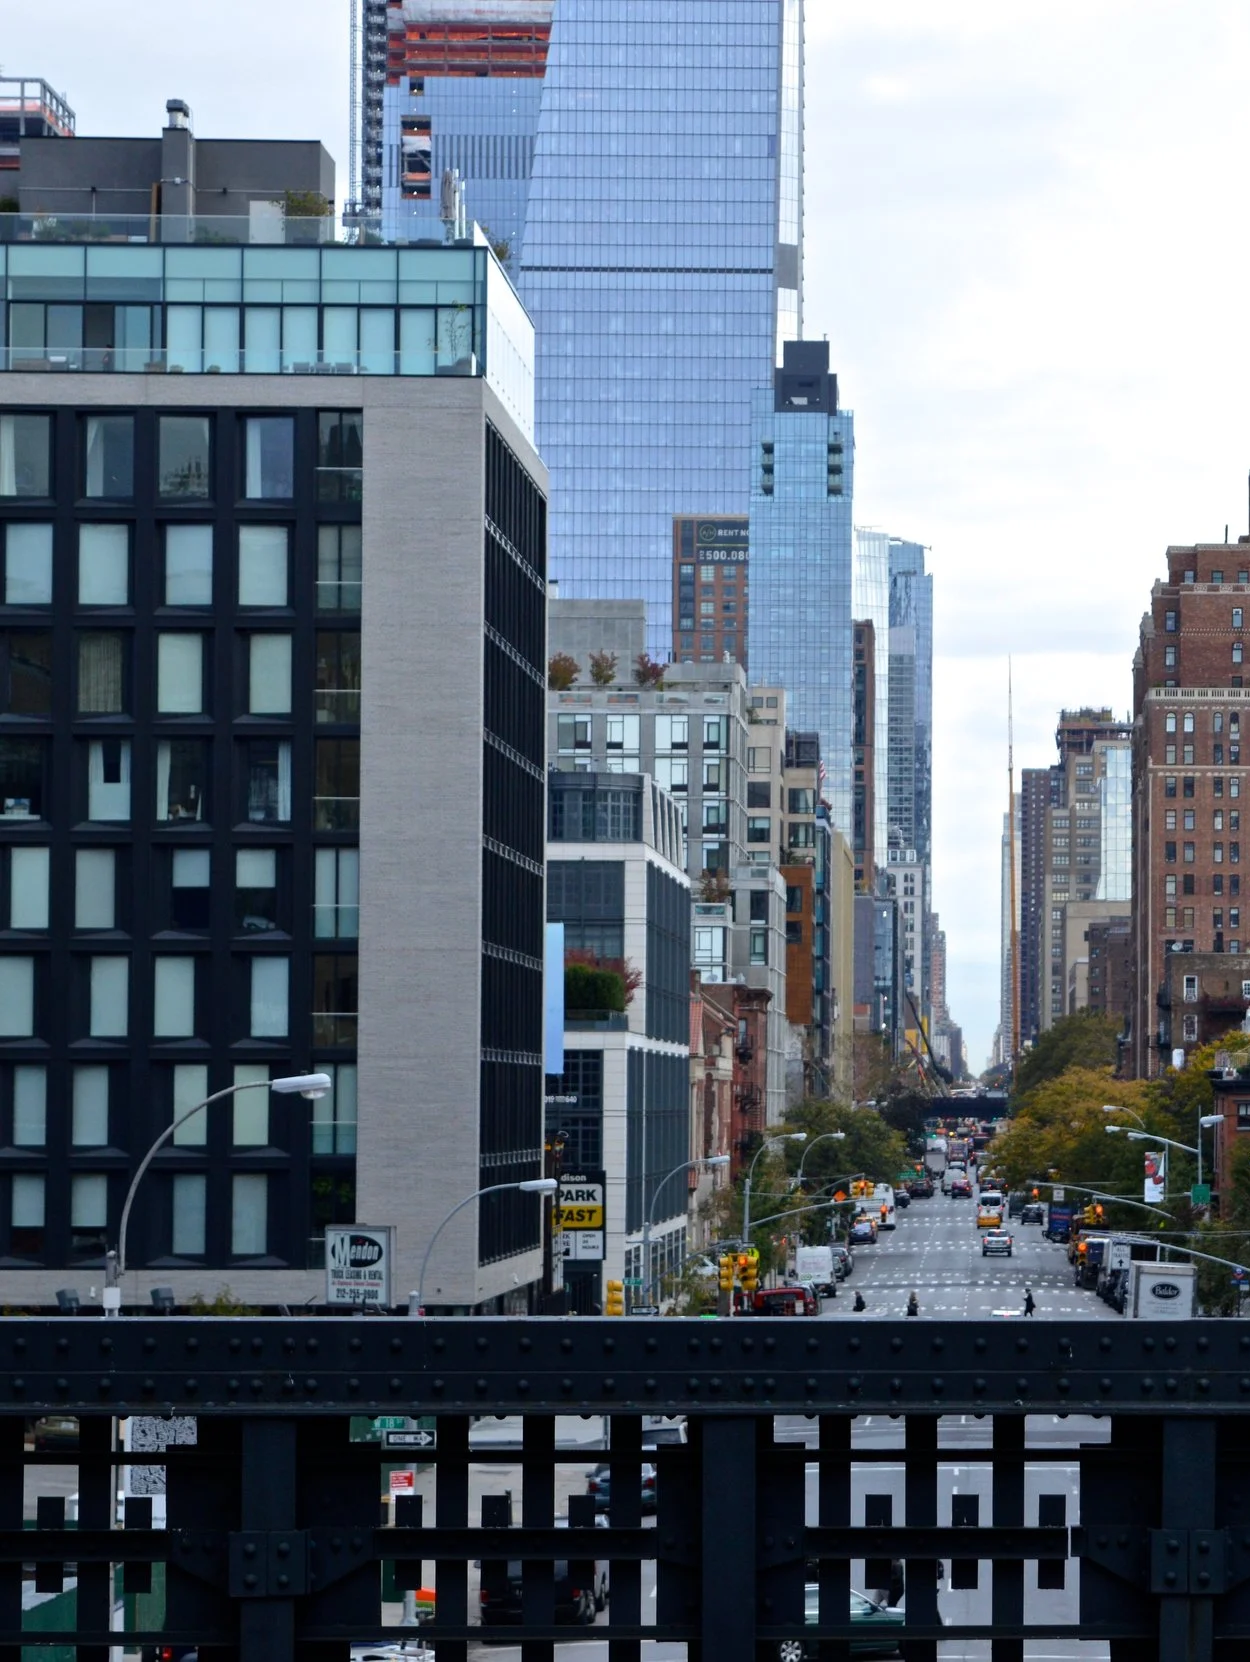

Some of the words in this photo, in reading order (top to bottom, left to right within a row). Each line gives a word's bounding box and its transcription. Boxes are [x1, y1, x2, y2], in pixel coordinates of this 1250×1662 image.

[560, 1174, 587, 1182] dison
[334, 1233, 379, 1268] Mendon
[374, 1419, 381, 1429] W
[386, 1419, 395, 1428] 18
